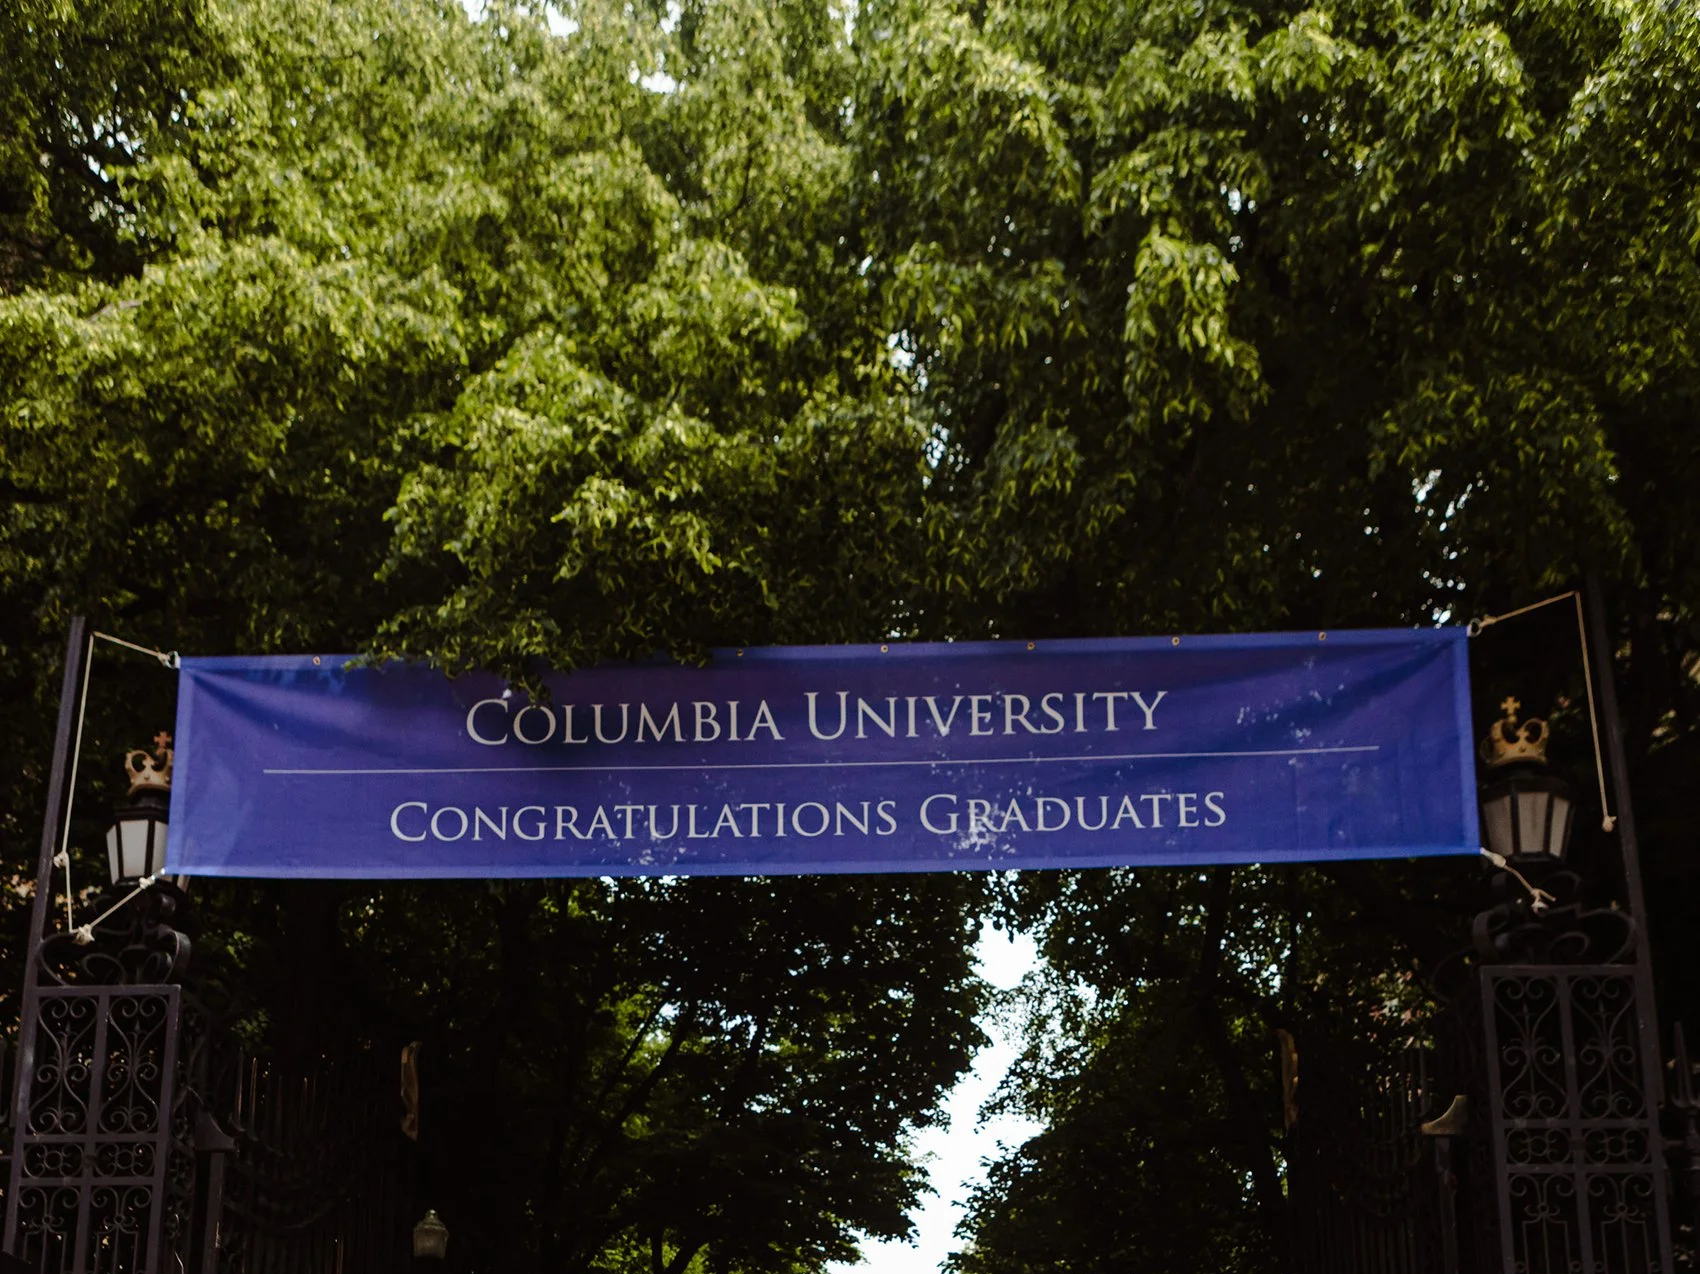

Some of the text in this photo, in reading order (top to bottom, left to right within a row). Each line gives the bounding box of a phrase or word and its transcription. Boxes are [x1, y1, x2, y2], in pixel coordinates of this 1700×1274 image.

[466, 691, 1168, 745] COLUMBIA UNIVERSITY
[390, 791, 1227, 842] CONGRATULATIONS GRADUATES
